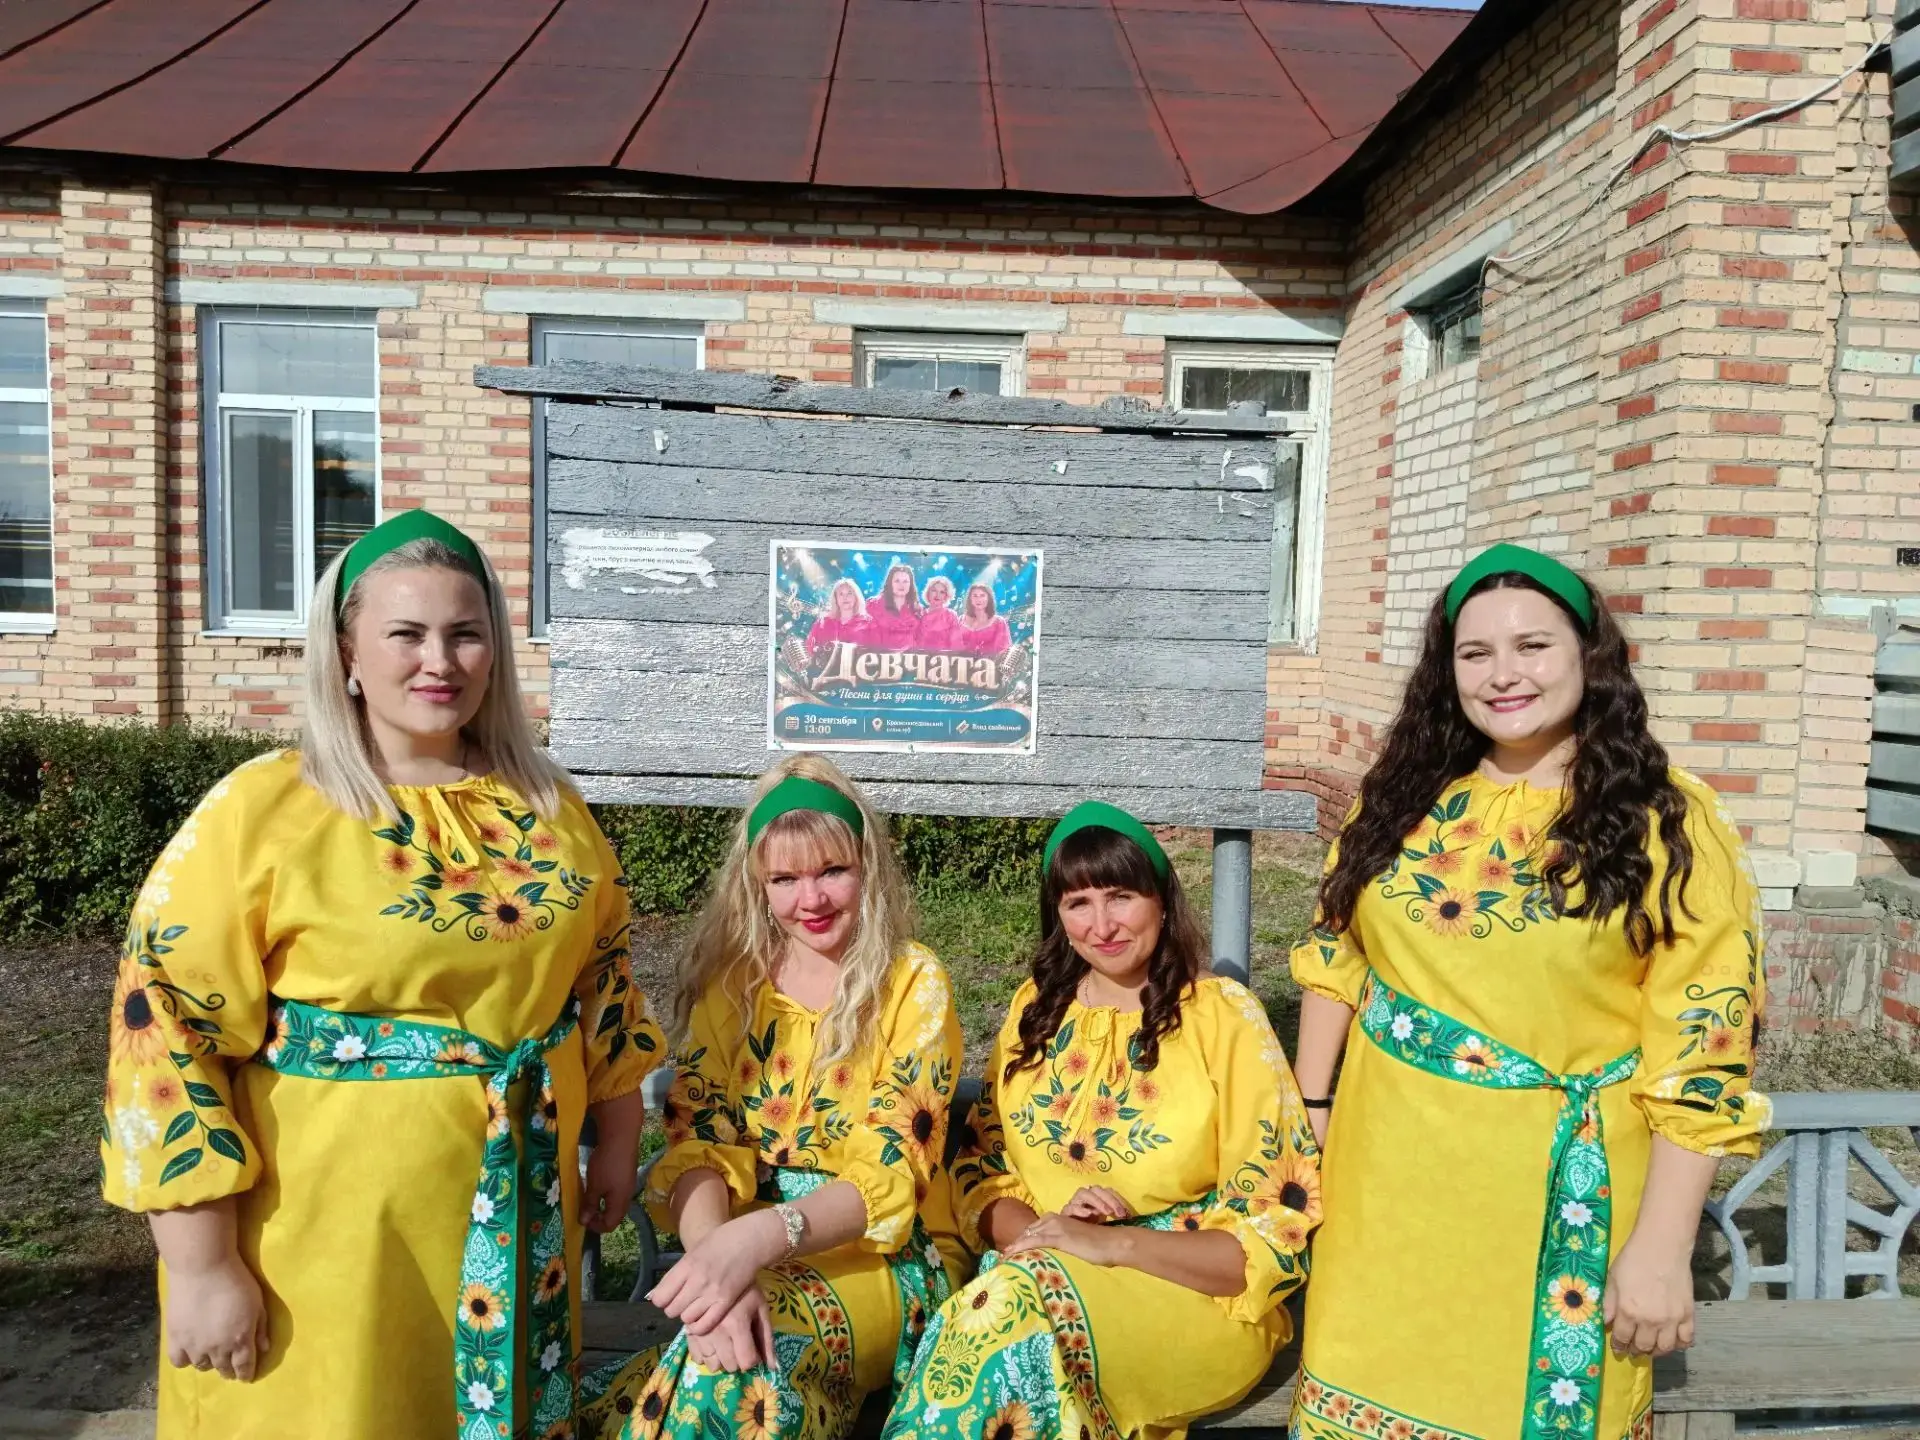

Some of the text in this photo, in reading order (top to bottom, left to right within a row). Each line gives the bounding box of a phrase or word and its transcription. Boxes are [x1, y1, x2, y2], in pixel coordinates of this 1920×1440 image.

[811, 640, 1000, 690] Девчата
[839, 688, 970, 706] Песни для души и сердца
[804, 714, 857, 726] 30 сентября
[804, 725, 832, 734] 13:00
